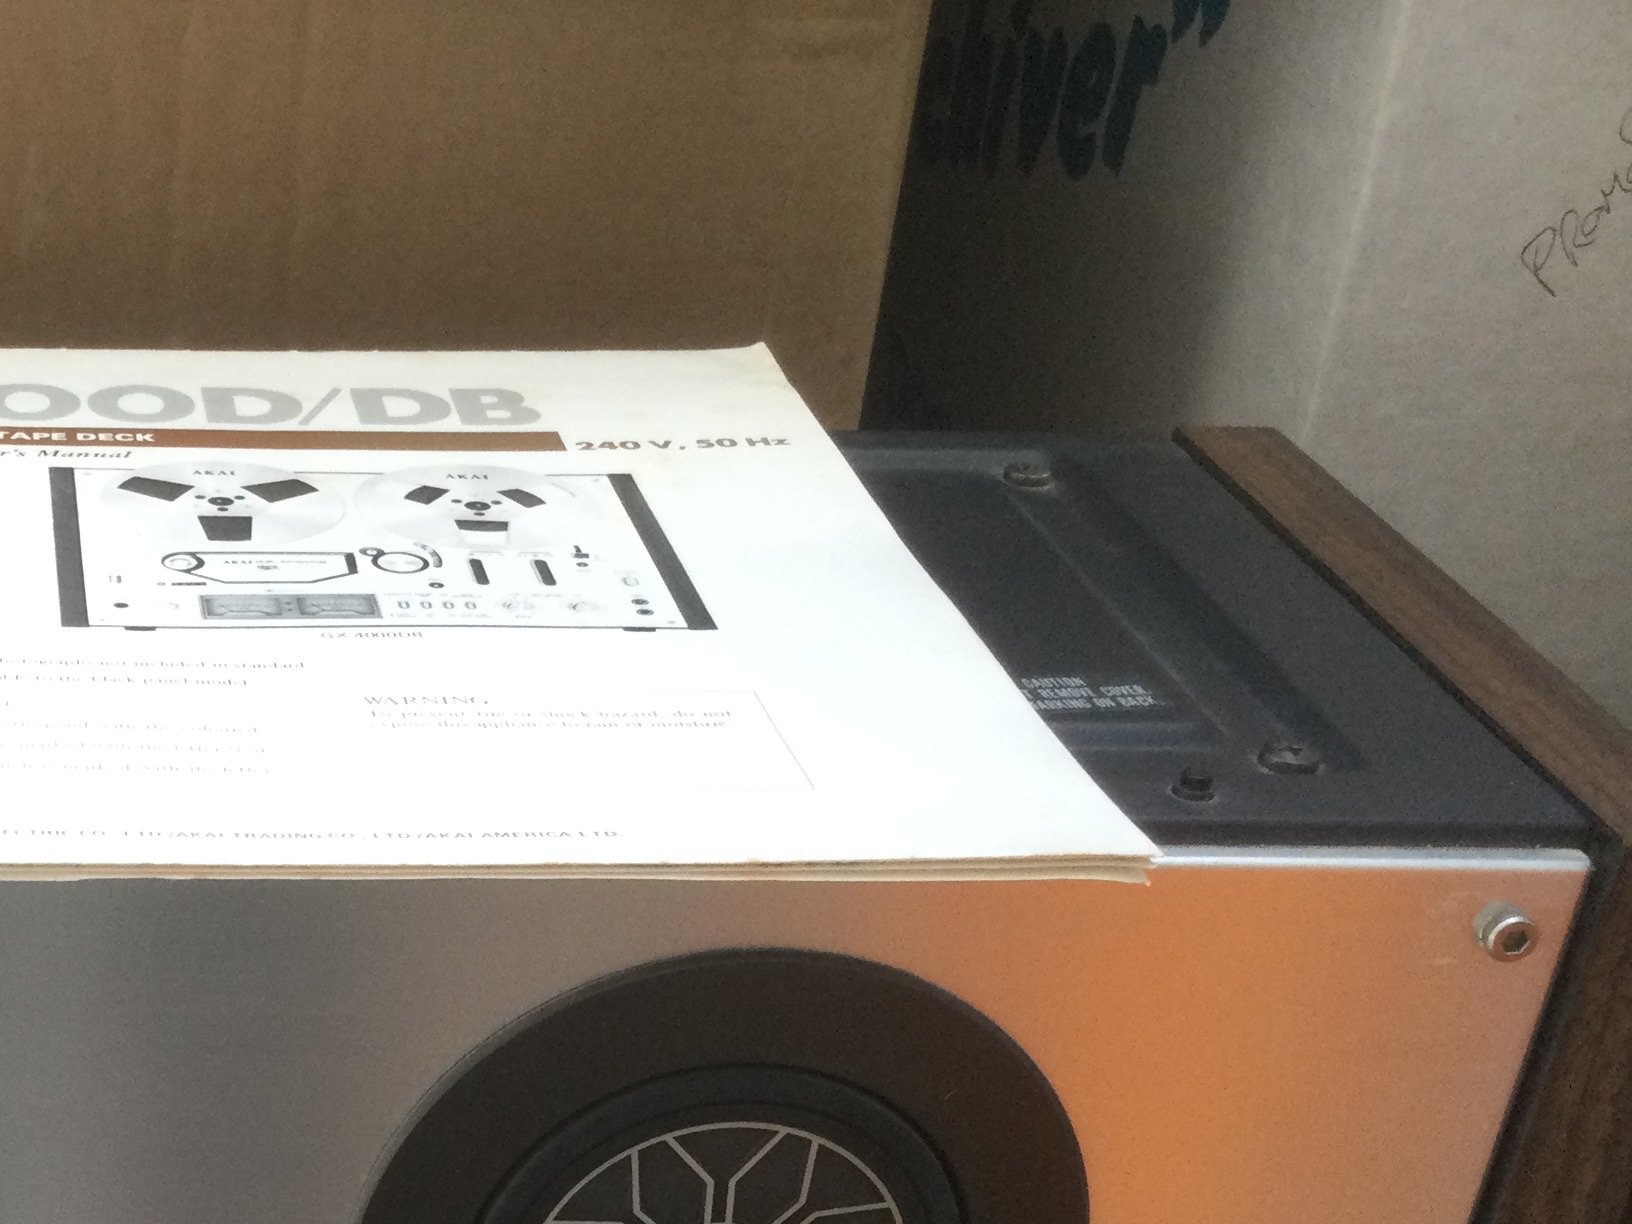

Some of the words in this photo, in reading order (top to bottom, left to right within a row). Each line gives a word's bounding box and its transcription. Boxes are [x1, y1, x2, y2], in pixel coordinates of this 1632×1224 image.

[76, 432, 155, 442] DECK
[575, 441, 641, 450] 240
[696, 438, 737, 448] 50
[745, 437, 790, 447] Hz
[37, 450, 133, 459] Manual
